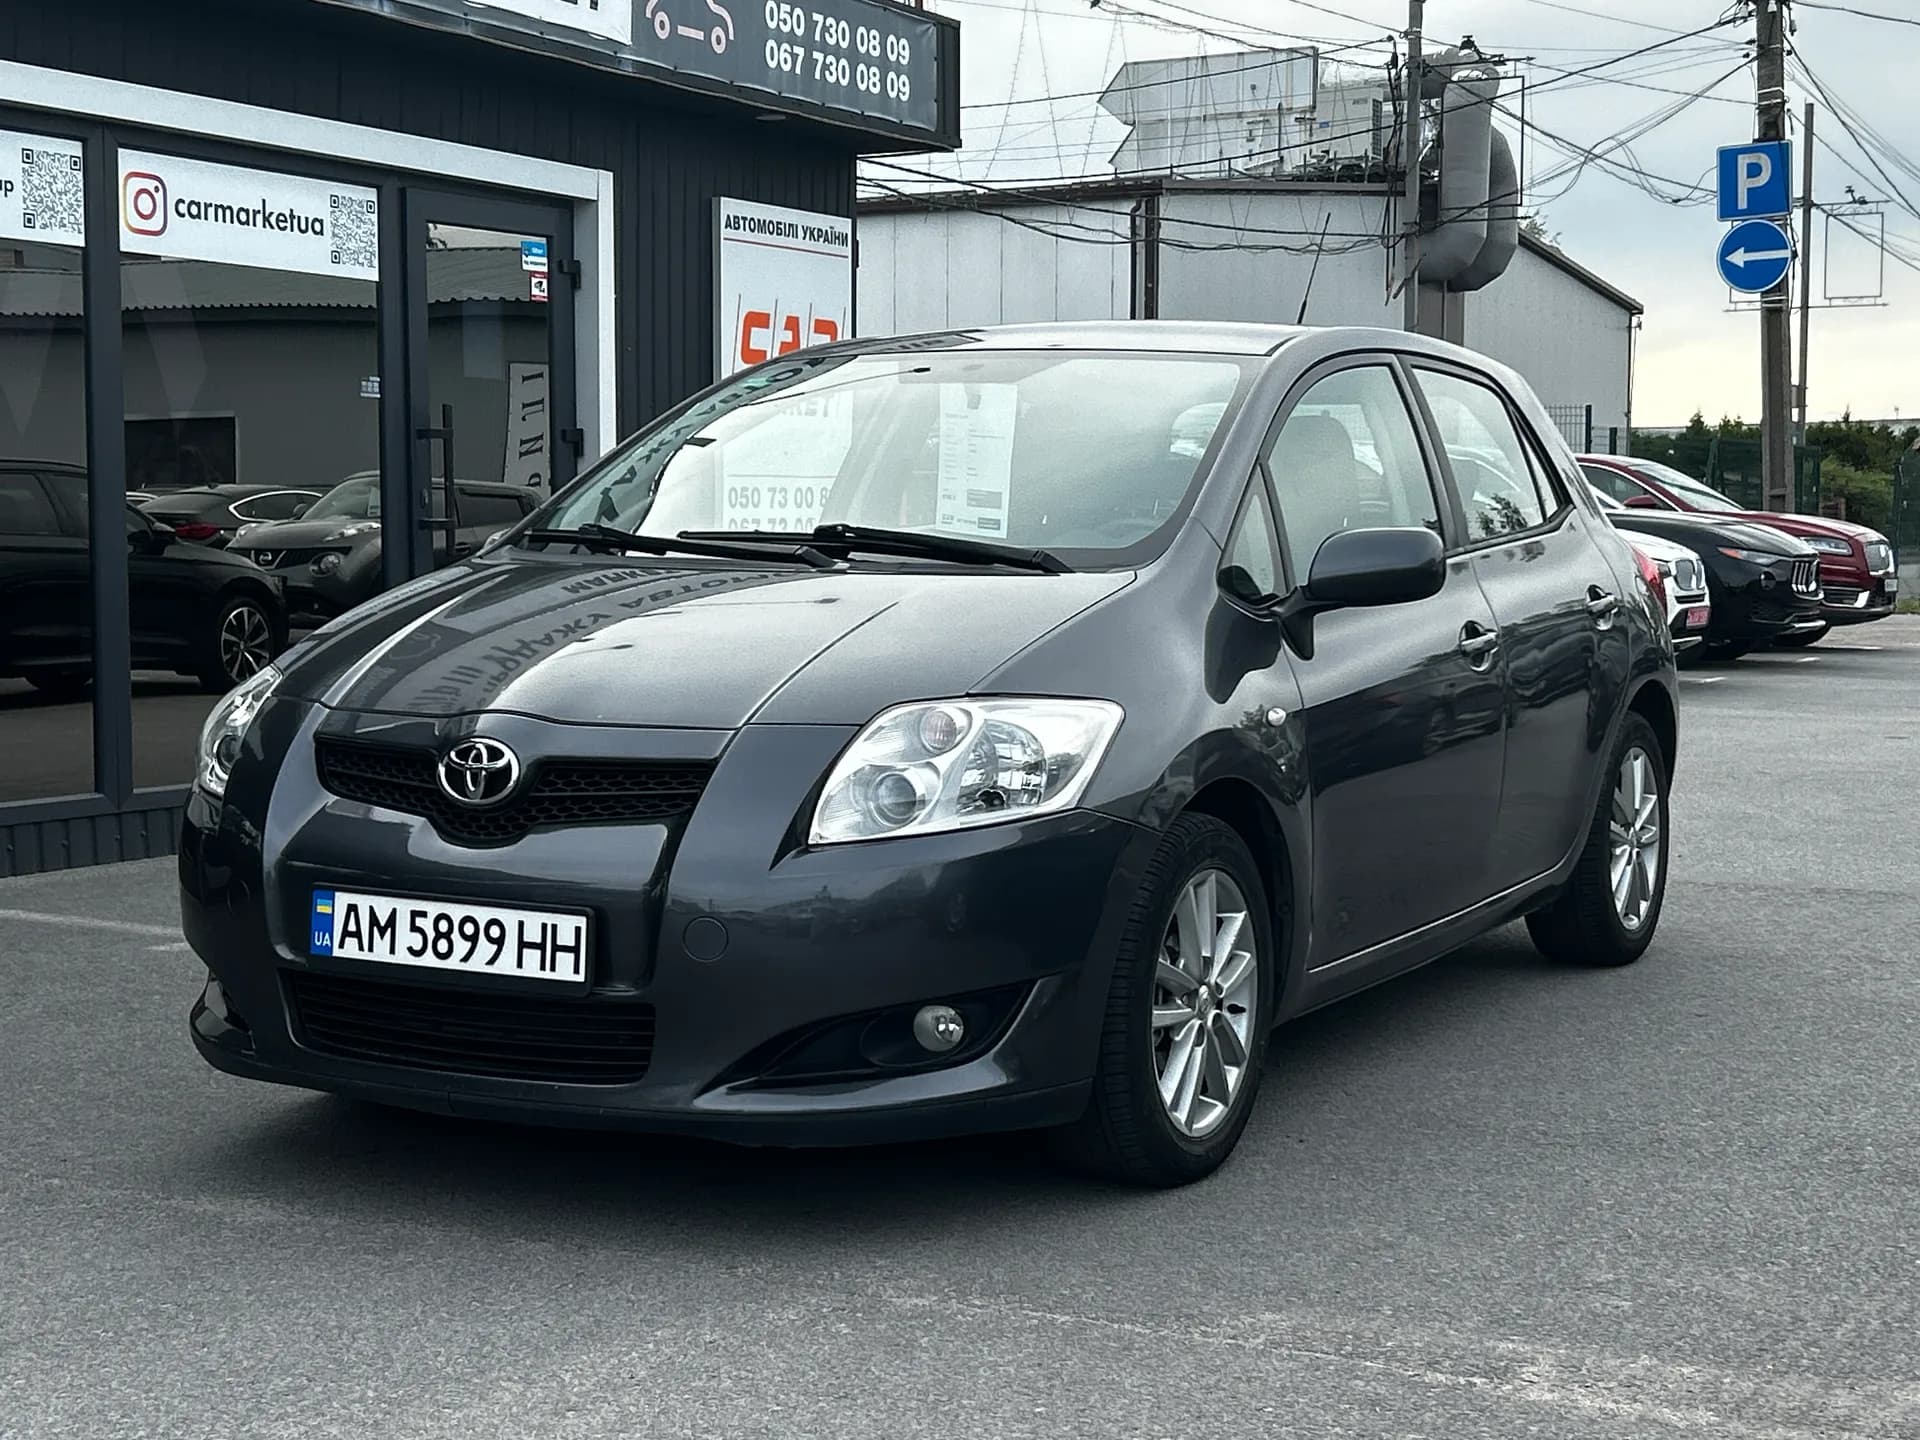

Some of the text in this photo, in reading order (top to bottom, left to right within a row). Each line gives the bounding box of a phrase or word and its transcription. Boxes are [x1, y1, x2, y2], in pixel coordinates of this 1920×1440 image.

[765, 0, 910, 65] 050 730 08 09
[765, 39, 910, 102] 067 730 08 09
[1736, 153, 1772, 210] P
[174, 198, 324, 236] carmarketua
[724, 214, 849, 247] АВТОМОБІЛІ УКРАЇНИ
[728, 487, 761, 509] 050
[767, 487, 788, 509] 73
[794, 487, 814, 509] 00
[314, 931, 331, 947] UA
[338, 903, 582, 975] AM 5899 HH
